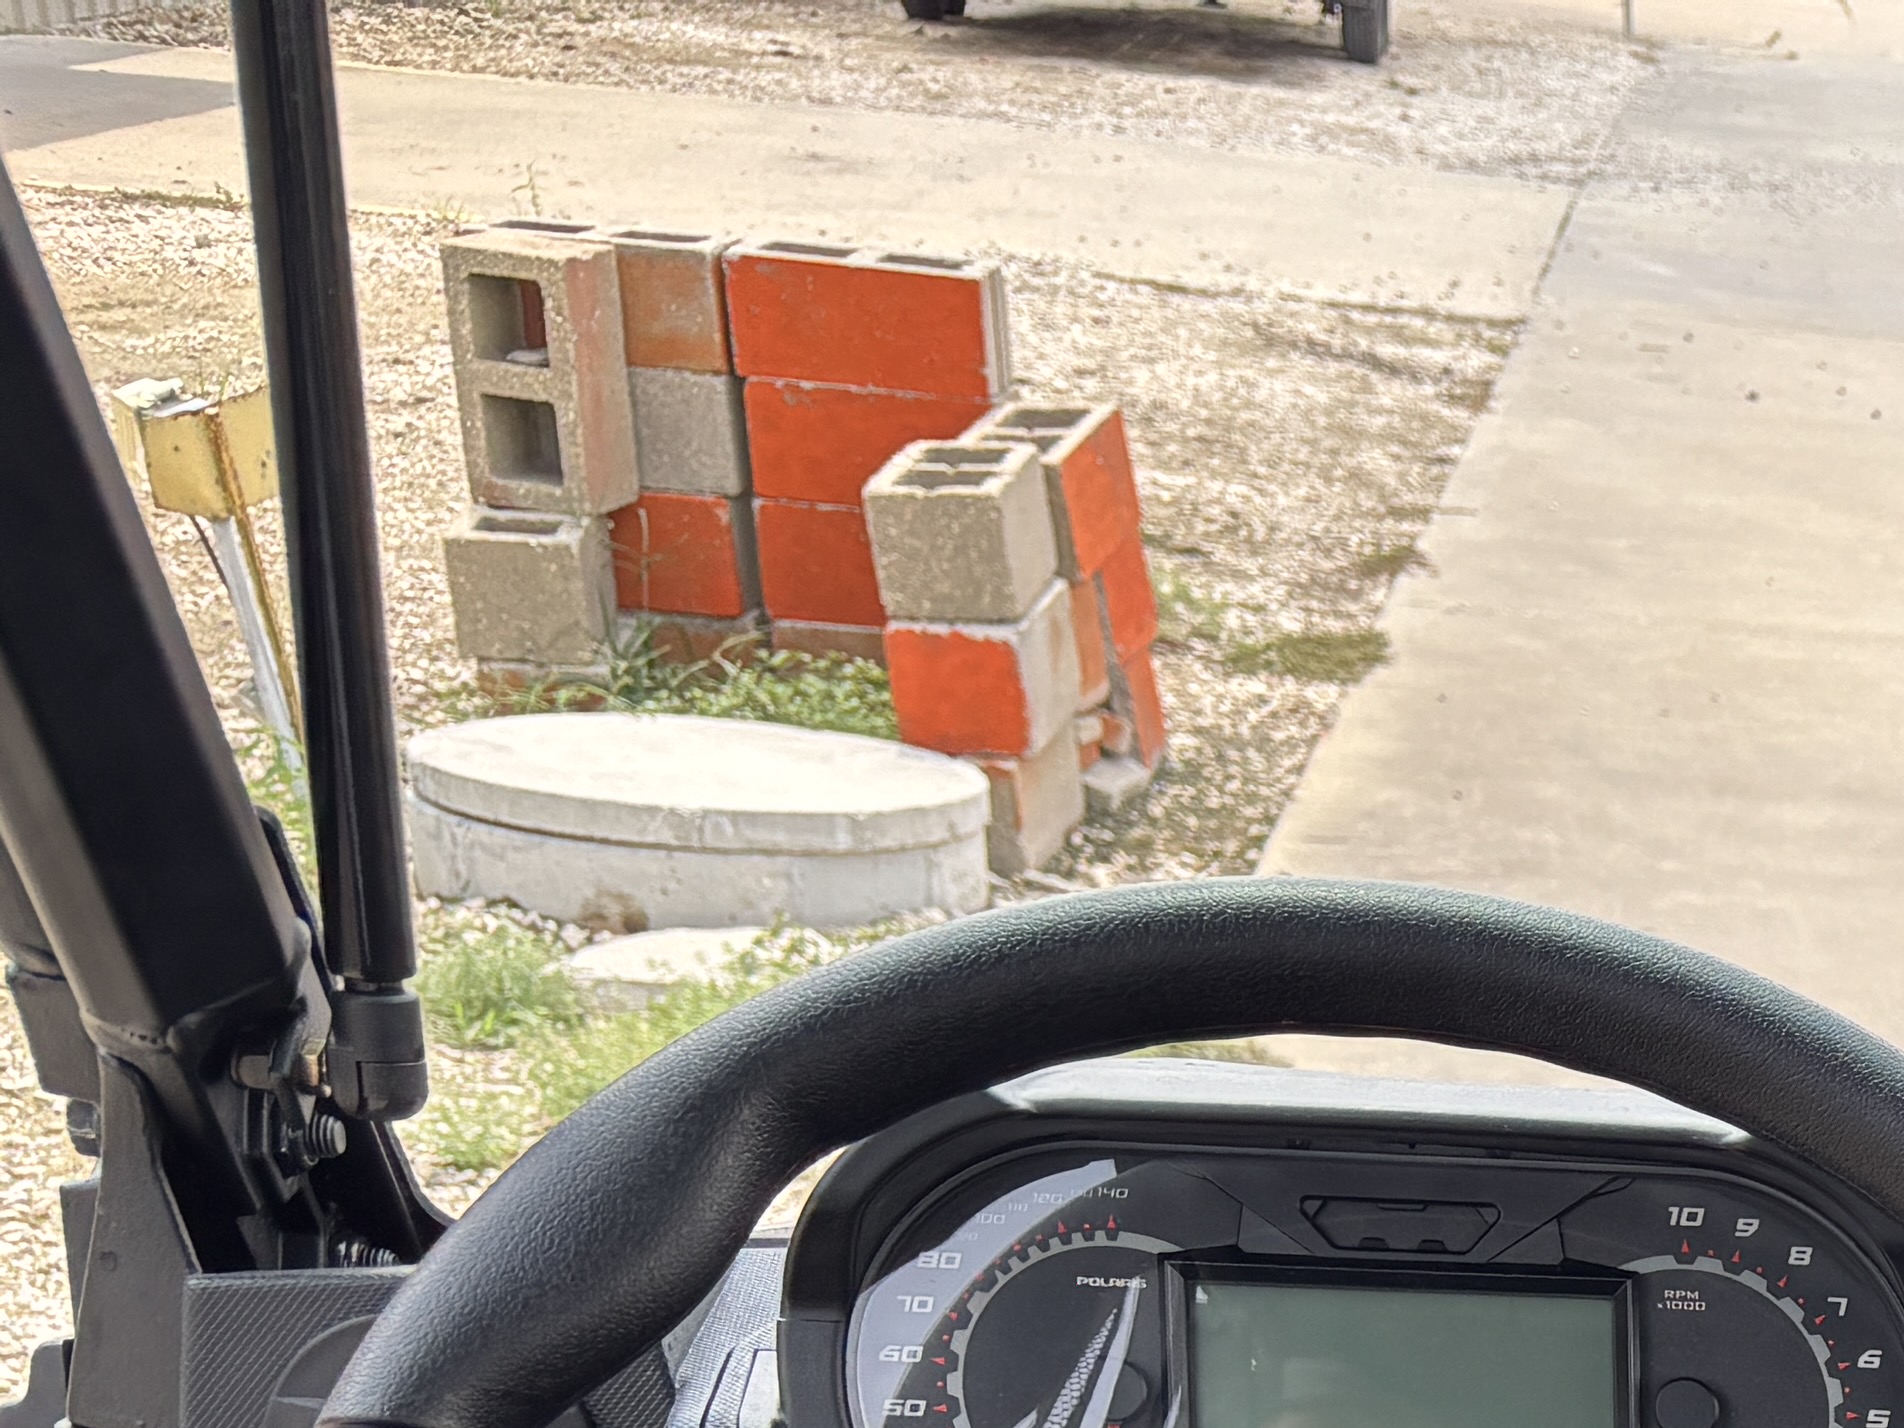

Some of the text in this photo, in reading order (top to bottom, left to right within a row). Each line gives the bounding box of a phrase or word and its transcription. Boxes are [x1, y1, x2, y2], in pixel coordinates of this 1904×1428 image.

[1033, 1193, 1063, 1204] 120
[1098, 1187, 1129, 1199] 140
[1668, 1206, 1705, 1226] 10
[1734, 1218, 1760, 1237] 9
[917, 1252, 961, 1269] 80
[1787, 1246, 1813, 1265] 8
[1076, 1276, 1147, 1289] POLARIS
[1664, 1290, 1699, 1299] RPM
[897, 1296, 933, 1313] 70
[1657, 1300, 1706, 1311] x1000
[1827, 1297, 1848, 1316] 7
[879, 1345, 924, 1363] 60
[1857, 1350, 1882, 1369] 6
[882, 1400, 926, 1416] 50
[1865, 1409, 1891, 1428] 5
